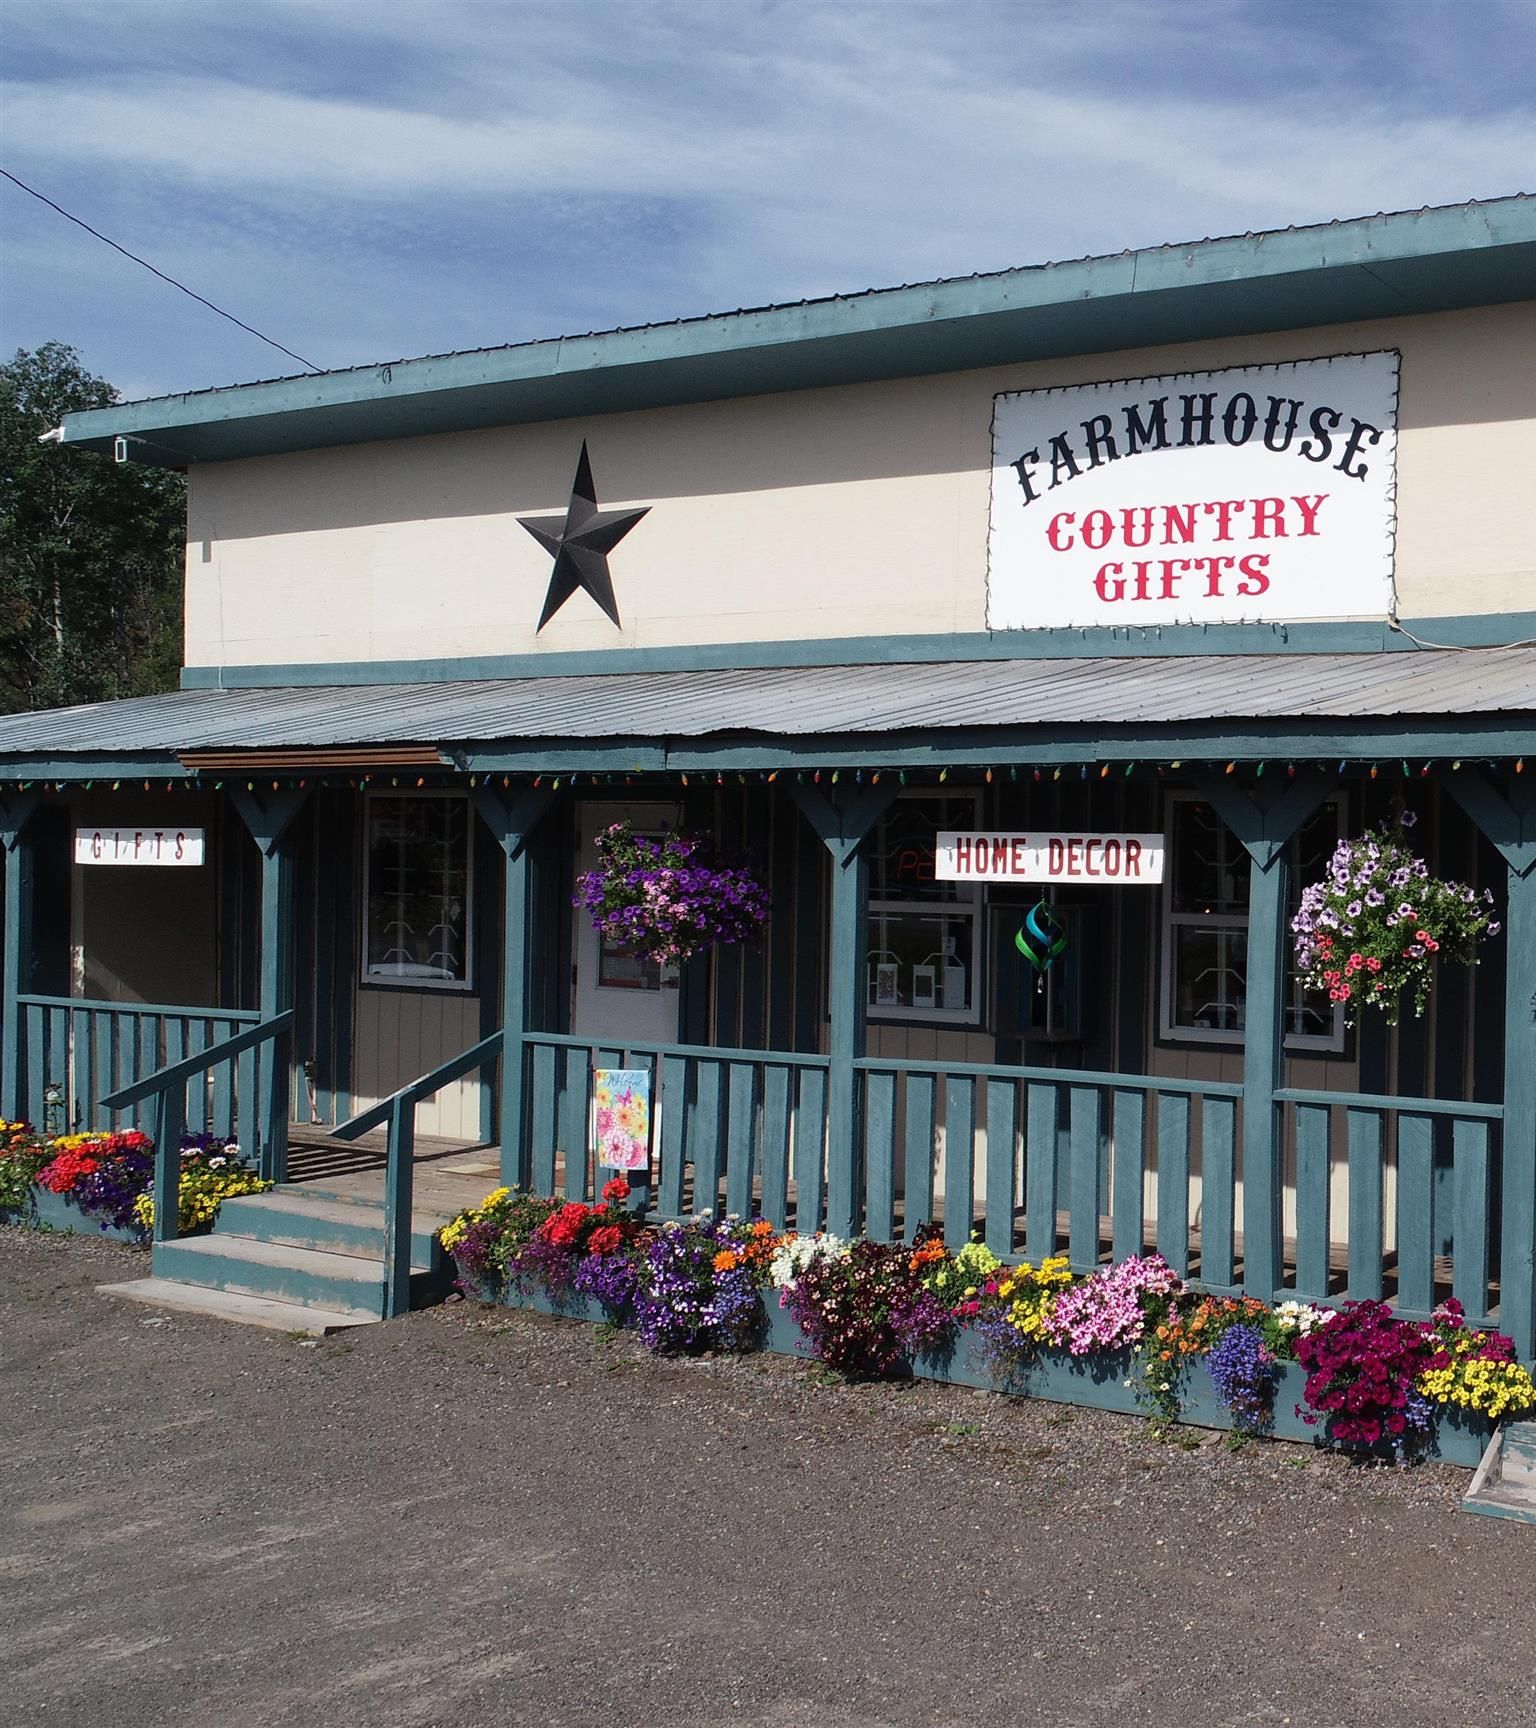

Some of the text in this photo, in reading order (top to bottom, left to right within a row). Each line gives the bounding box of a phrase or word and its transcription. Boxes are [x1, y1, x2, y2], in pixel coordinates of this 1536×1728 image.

[1010, 392, 1384, 507] FARMHOUSE
[1045, 494, 1330, 551] COUNTRY
[1092, 554, 1271, 602] GIFTS
[93, 832, 185, 860] GIFTS
[956, 837, 1142, 877] HOME DECOR
